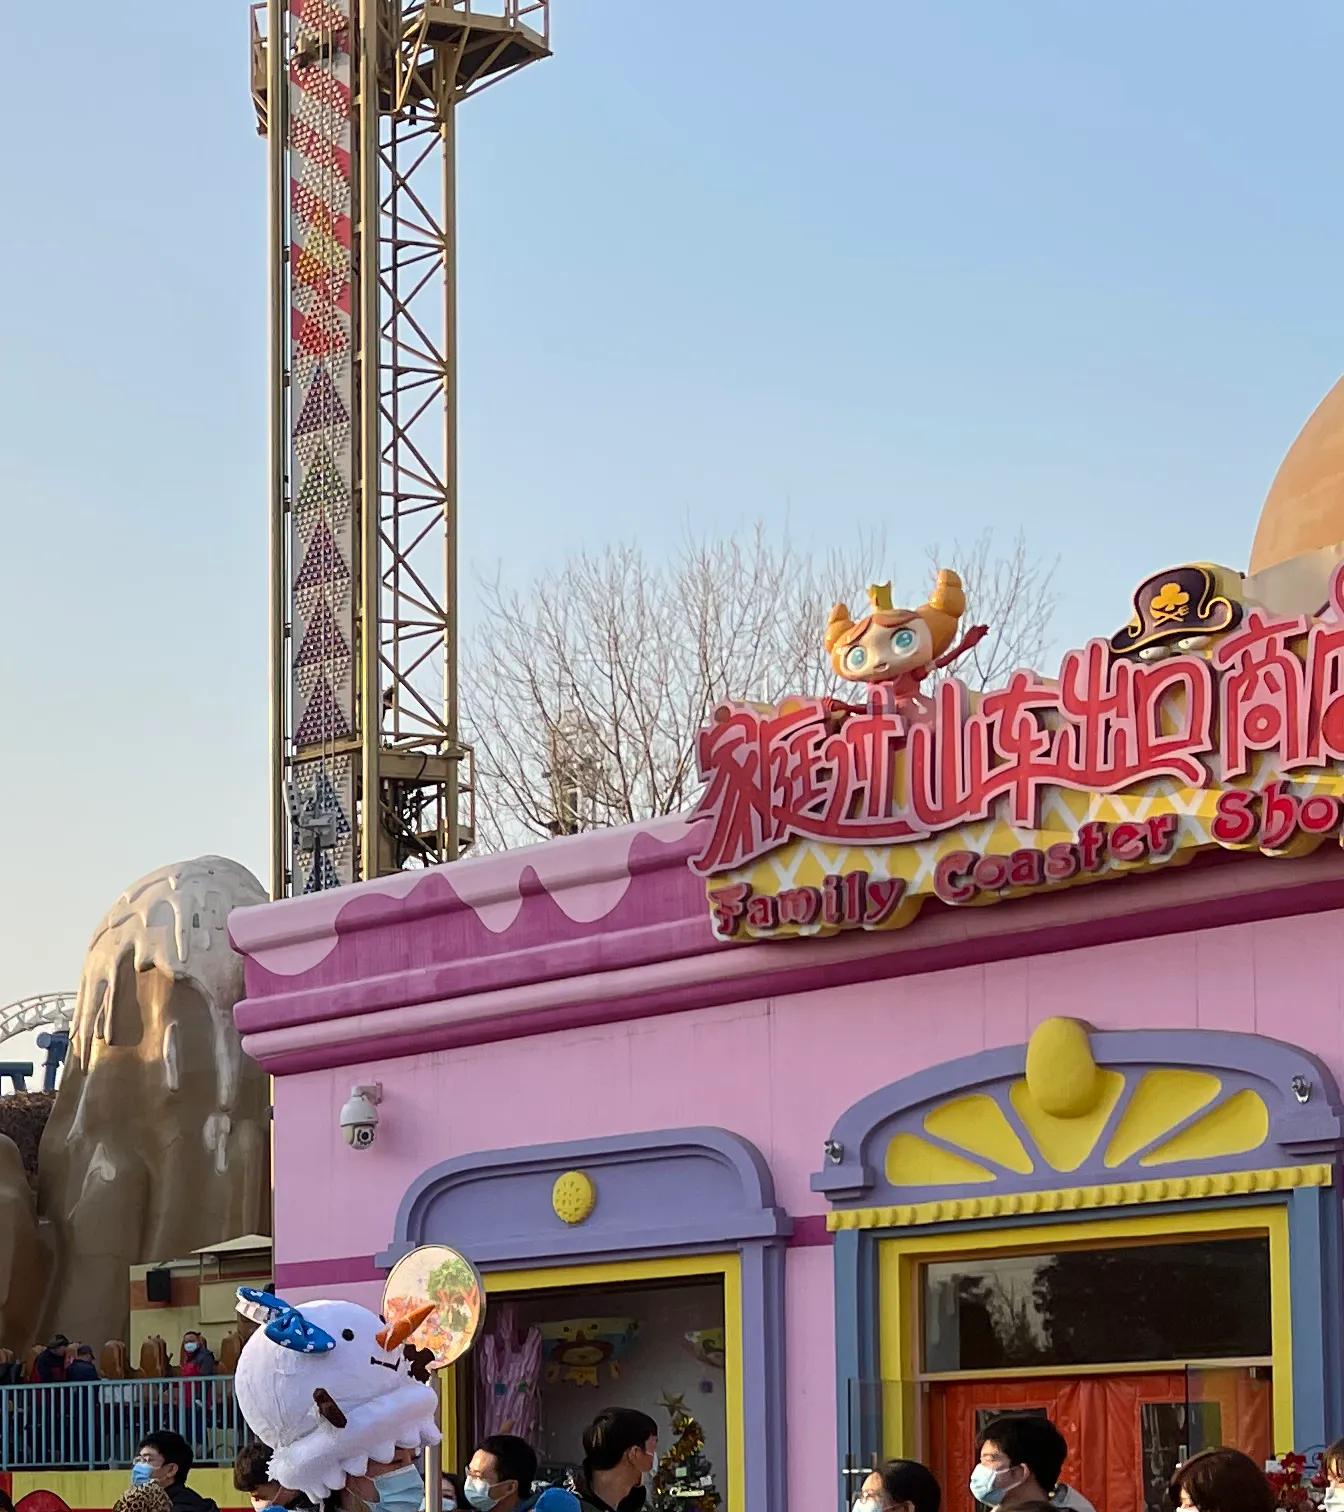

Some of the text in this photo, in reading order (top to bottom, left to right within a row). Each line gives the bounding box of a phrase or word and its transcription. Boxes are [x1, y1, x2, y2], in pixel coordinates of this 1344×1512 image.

[710, 780, 1344, 936] Family Coaster Sho
